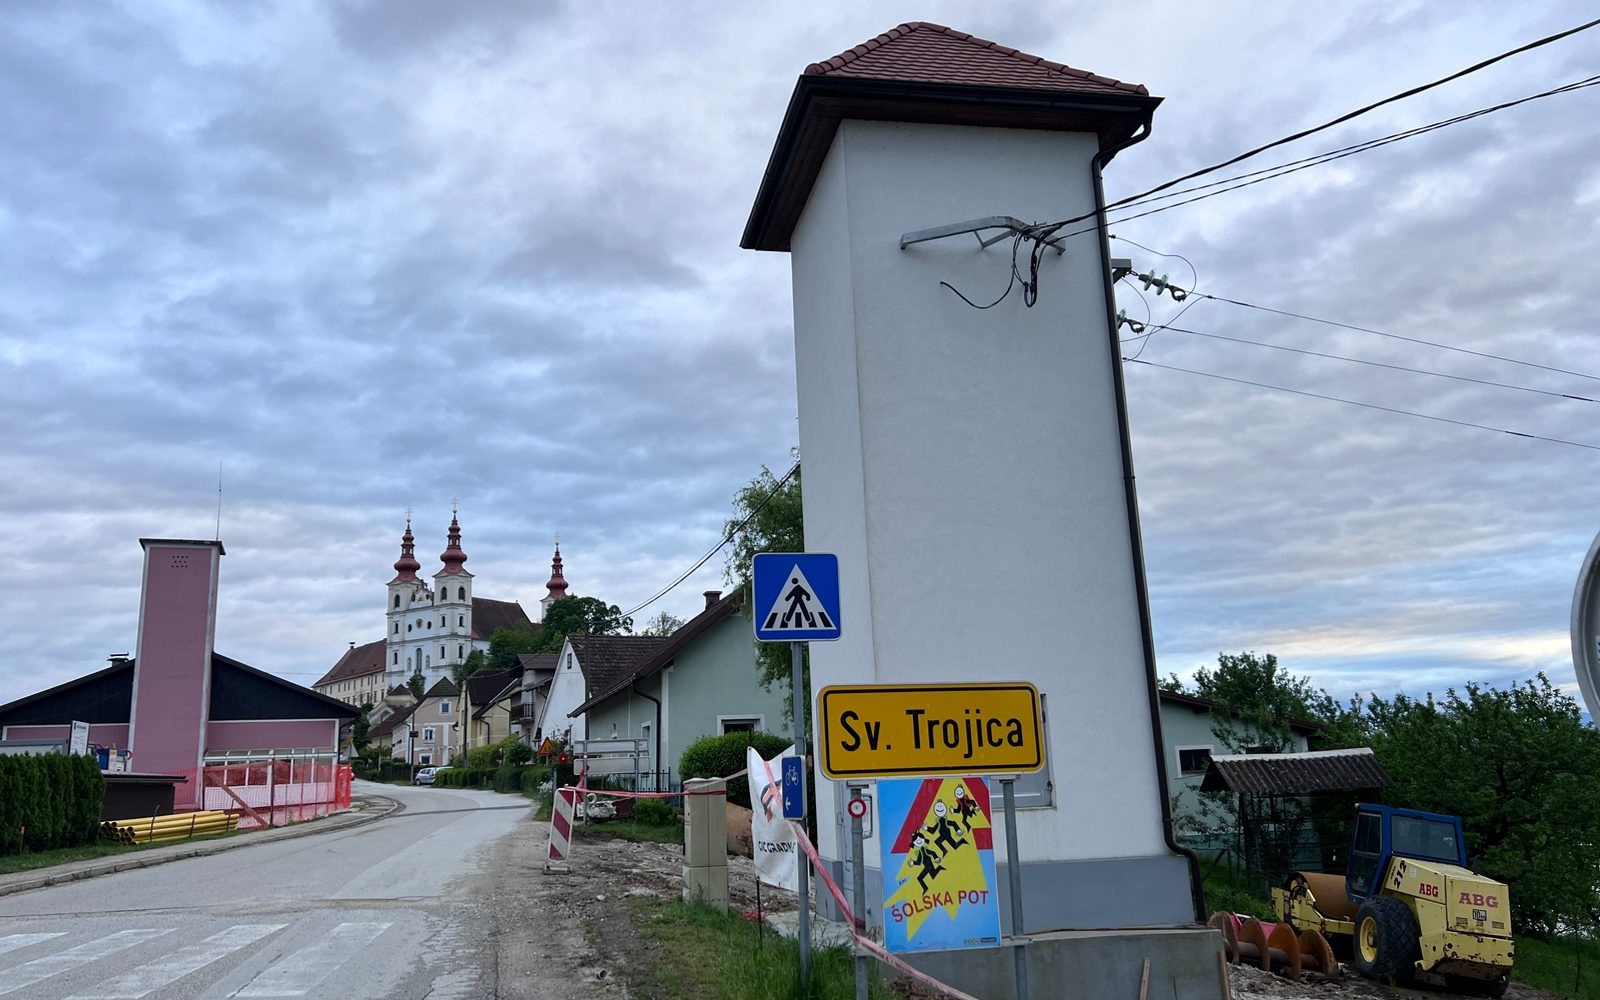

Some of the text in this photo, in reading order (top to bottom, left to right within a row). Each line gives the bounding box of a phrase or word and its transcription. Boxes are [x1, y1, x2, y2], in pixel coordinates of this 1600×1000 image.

[840, 708, 1024, 759] Sv. Trojica
[1393, 860, 1407, 889] 212
[1419, 883, 1439, 897] ABG
[1458, 892, 1499, 908] ABG
[891, 890, 989, 922] ŠOLSKA POT
